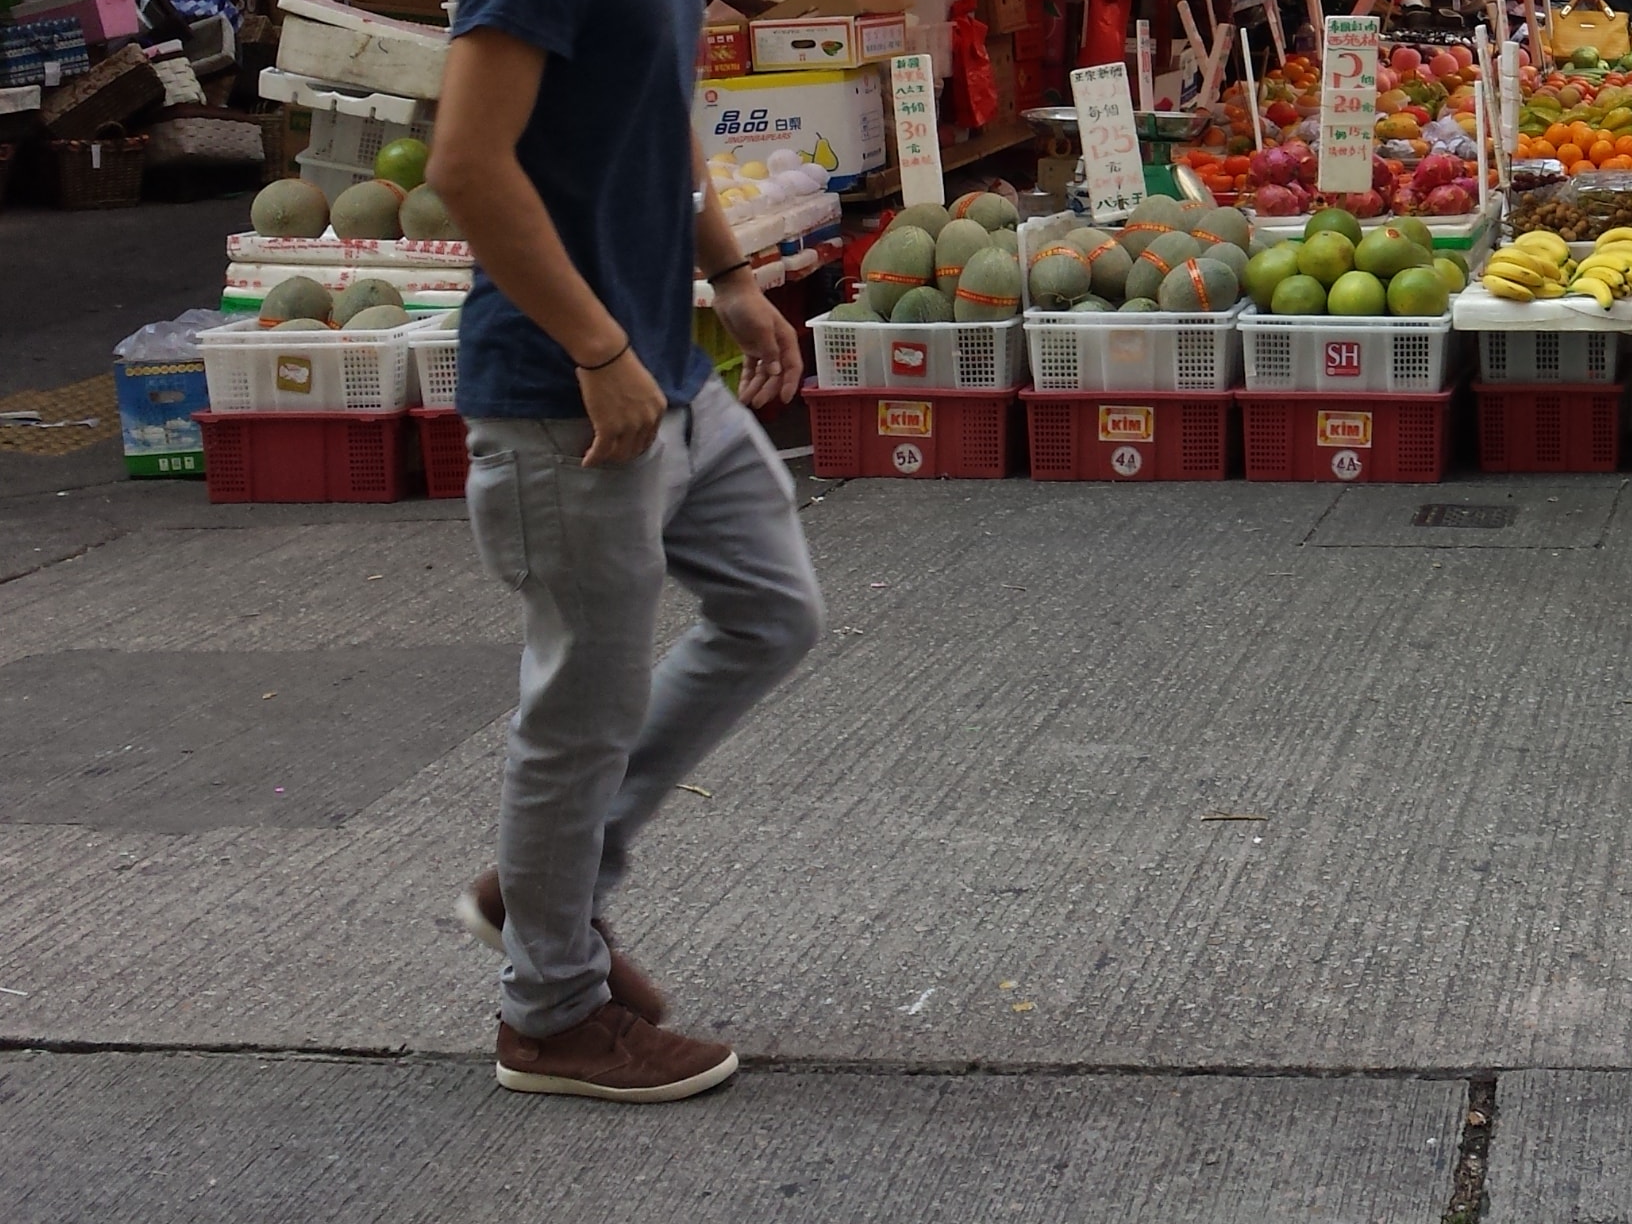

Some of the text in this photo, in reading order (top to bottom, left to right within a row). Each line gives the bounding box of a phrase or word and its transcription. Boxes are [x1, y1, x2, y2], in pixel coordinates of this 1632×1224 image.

[714, 109, 802, 136] 晶品 白梨
[1088, 103, 1119, 122] 每個
[900, 120, 927, 141] 30
[1089, 125, 1135, 160] 25
[1327, 343, 1359, 367] SH
[896, 449, 919, 466] 5A
[1115, 452, 1136, 467] 4A
